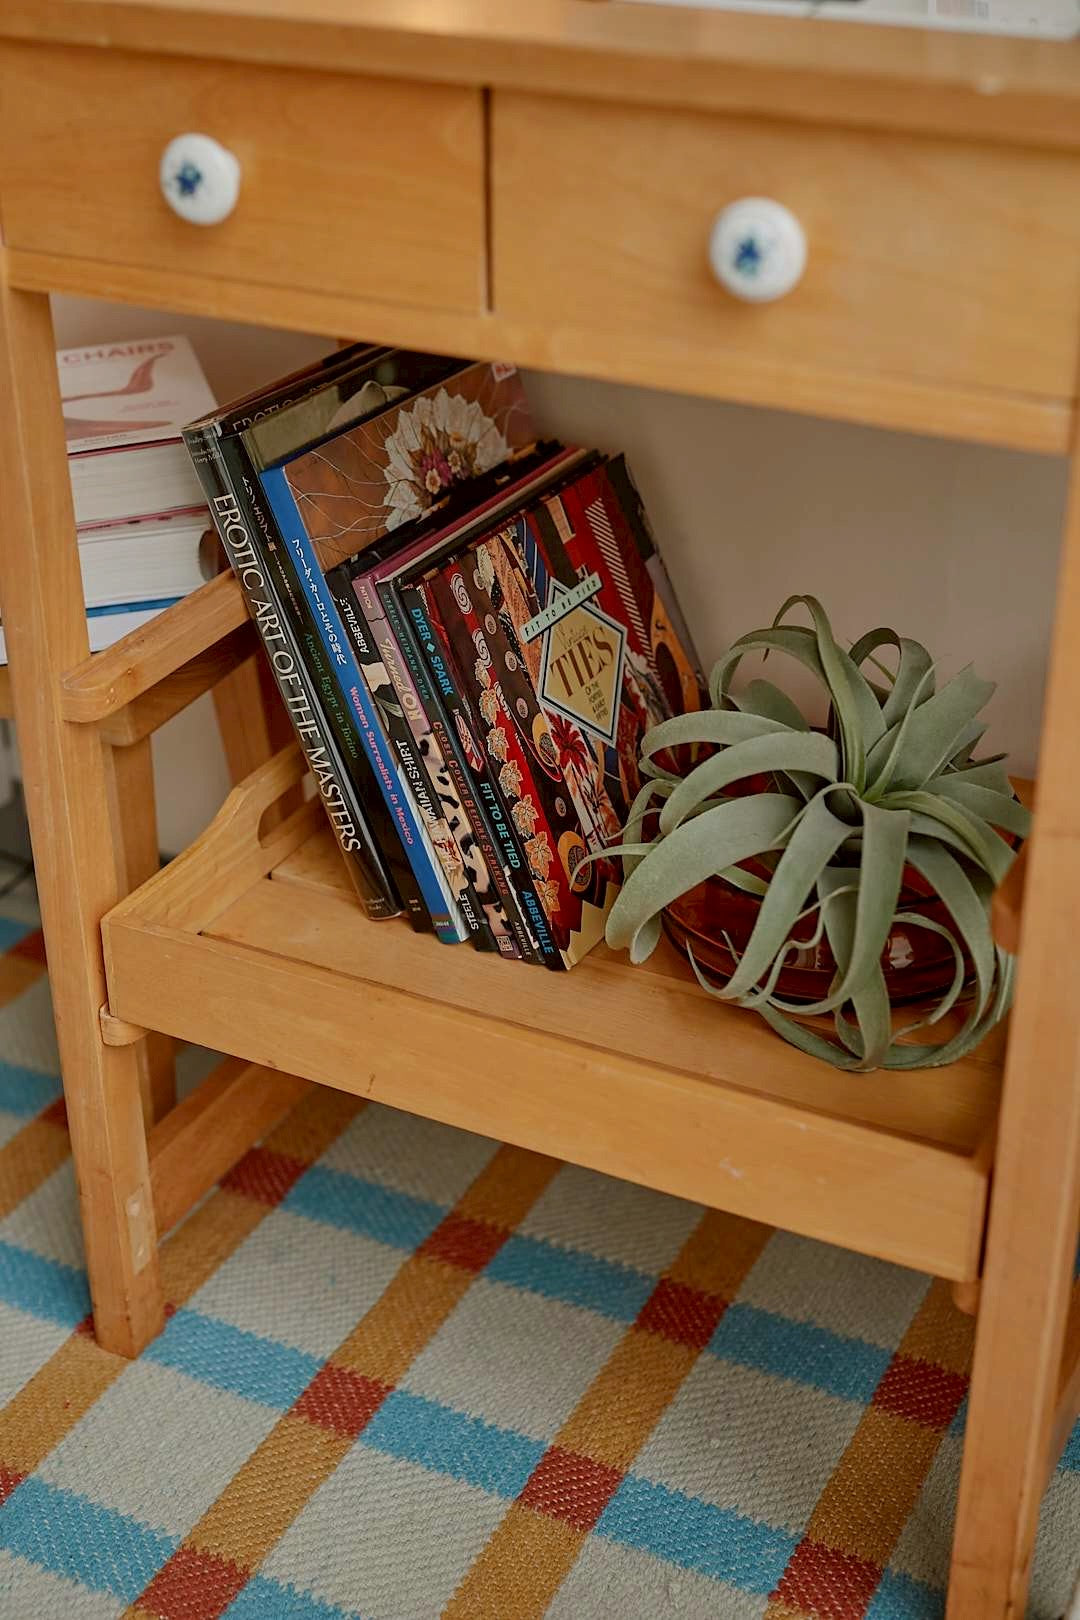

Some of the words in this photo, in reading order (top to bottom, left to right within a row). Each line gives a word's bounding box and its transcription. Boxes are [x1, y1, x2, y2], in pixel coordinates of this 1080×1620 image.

[63, 342, 174, 363] CHAIRS
[212, 491, 266, 592] EROTIC
[250, 593, 286, 649] ART
[289, 537, 347, 666] フリーダ・カーロとその時代
[270, 647, 301, 690] OF
[303, 631, 325, 673] Ancient
[410, 606, 432, 641] DYER
[429, 654, 454, 696] SPARK
[550, 627, 614, 698] TIES
[285, 688, 320, 742] THE
[320, 675, 338, 708] Egypt
[335, 711, 345, 723] in
[339, 723, 360, 759] Torino
[348, 686, 371, 728] Women
[364, 730, 395, 790] Surrealists
[389, 792, 399, 804] in
[394, 805, 415, 845] Mexico
[395, 737, 420, 780] SHIRT
[305, 743, 361, 854] MASTERS
[432, 720, 453, 757] CLOSE
[447, 758, 469, 794] COVER
[481, 842, 509, 897] STRIKING
[479, 781, 495, 804] FIT
[488, 803, 502, 821] TO
[496, 821, 509, 839] BE
[503, 840, 521, 869] TIED
[458, 892, 479, 930] STEELE
[521, 888, 554, 955] ABBEVILLE
